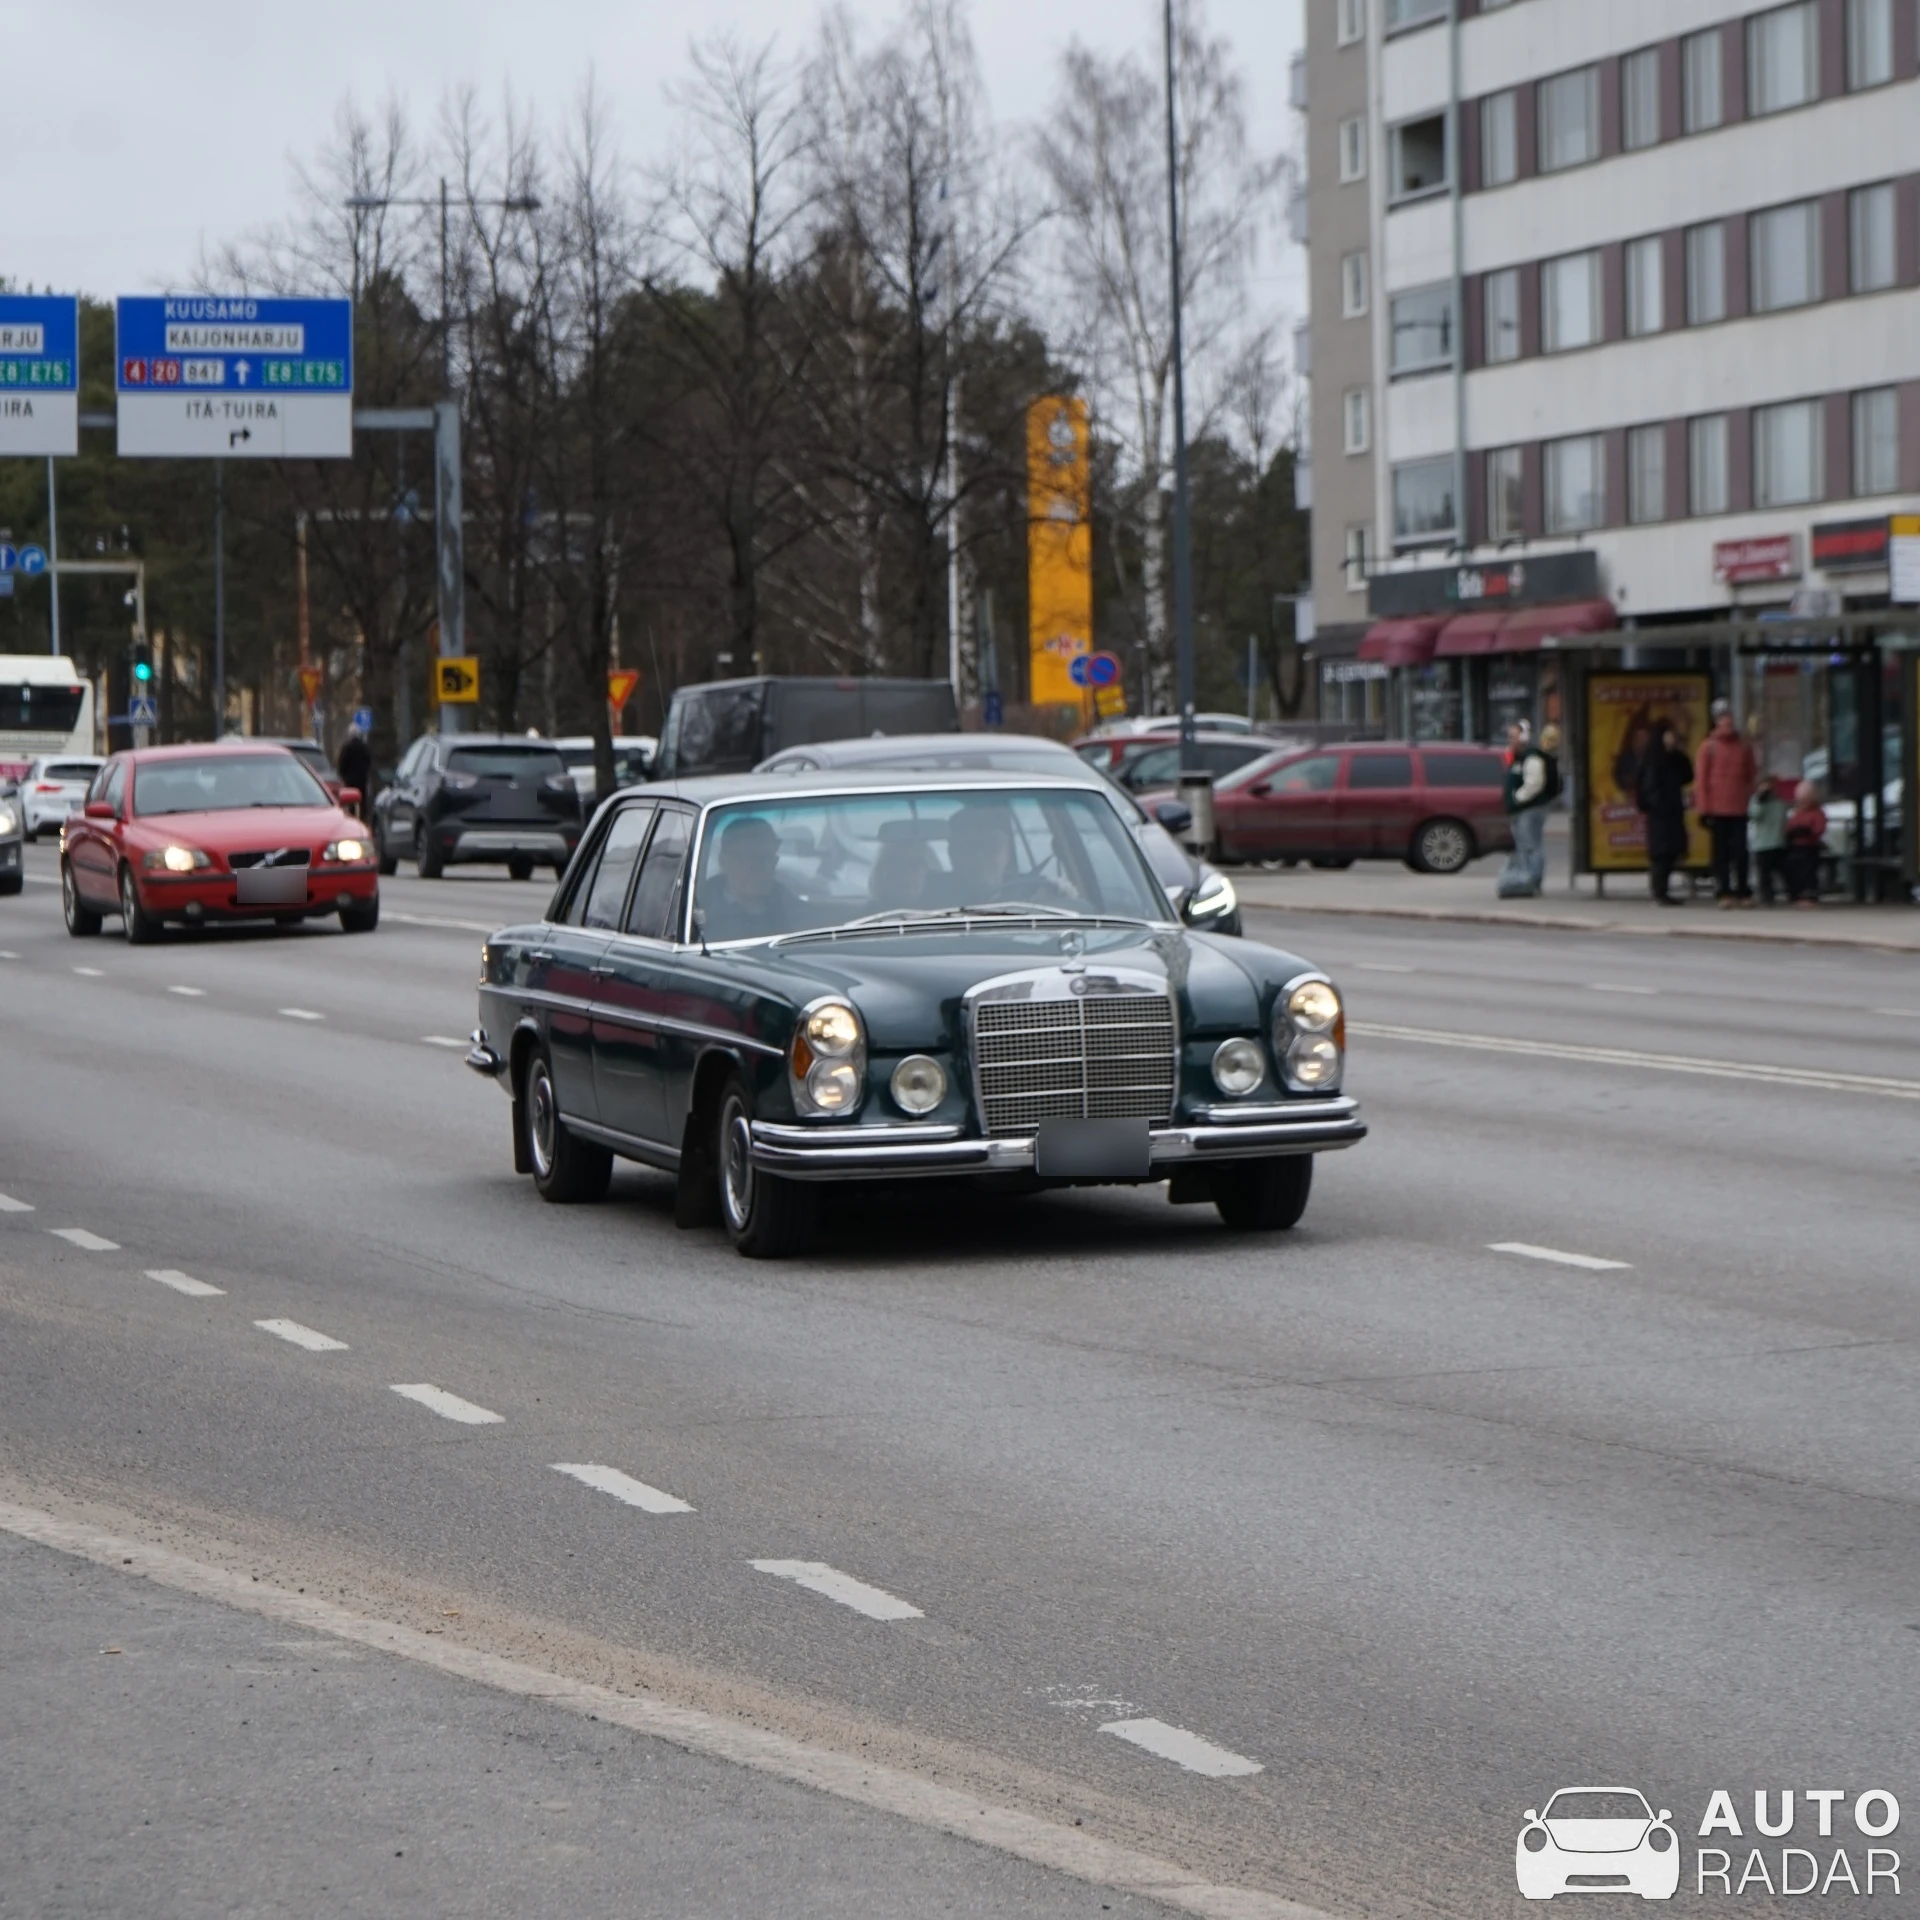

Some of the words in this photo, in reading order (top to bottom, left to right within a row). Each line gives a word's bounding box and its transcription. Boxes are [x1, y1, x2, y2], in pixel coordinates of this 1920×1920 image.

[164, 300, 258, 320] KUUSAMO
[169, 330, 299, 347] KAIJONHARJU
[30, 360, 63, 382] E75
[130, 361, 141, 381] 4
[155, 361, 178, 381] 20
[268, 361, 291, 382] E8
[305, 361, 337, 382] E75
[0, 399, 34, 418] IRA
[185, 398, 278, 419] ITÄ-TUIRA
